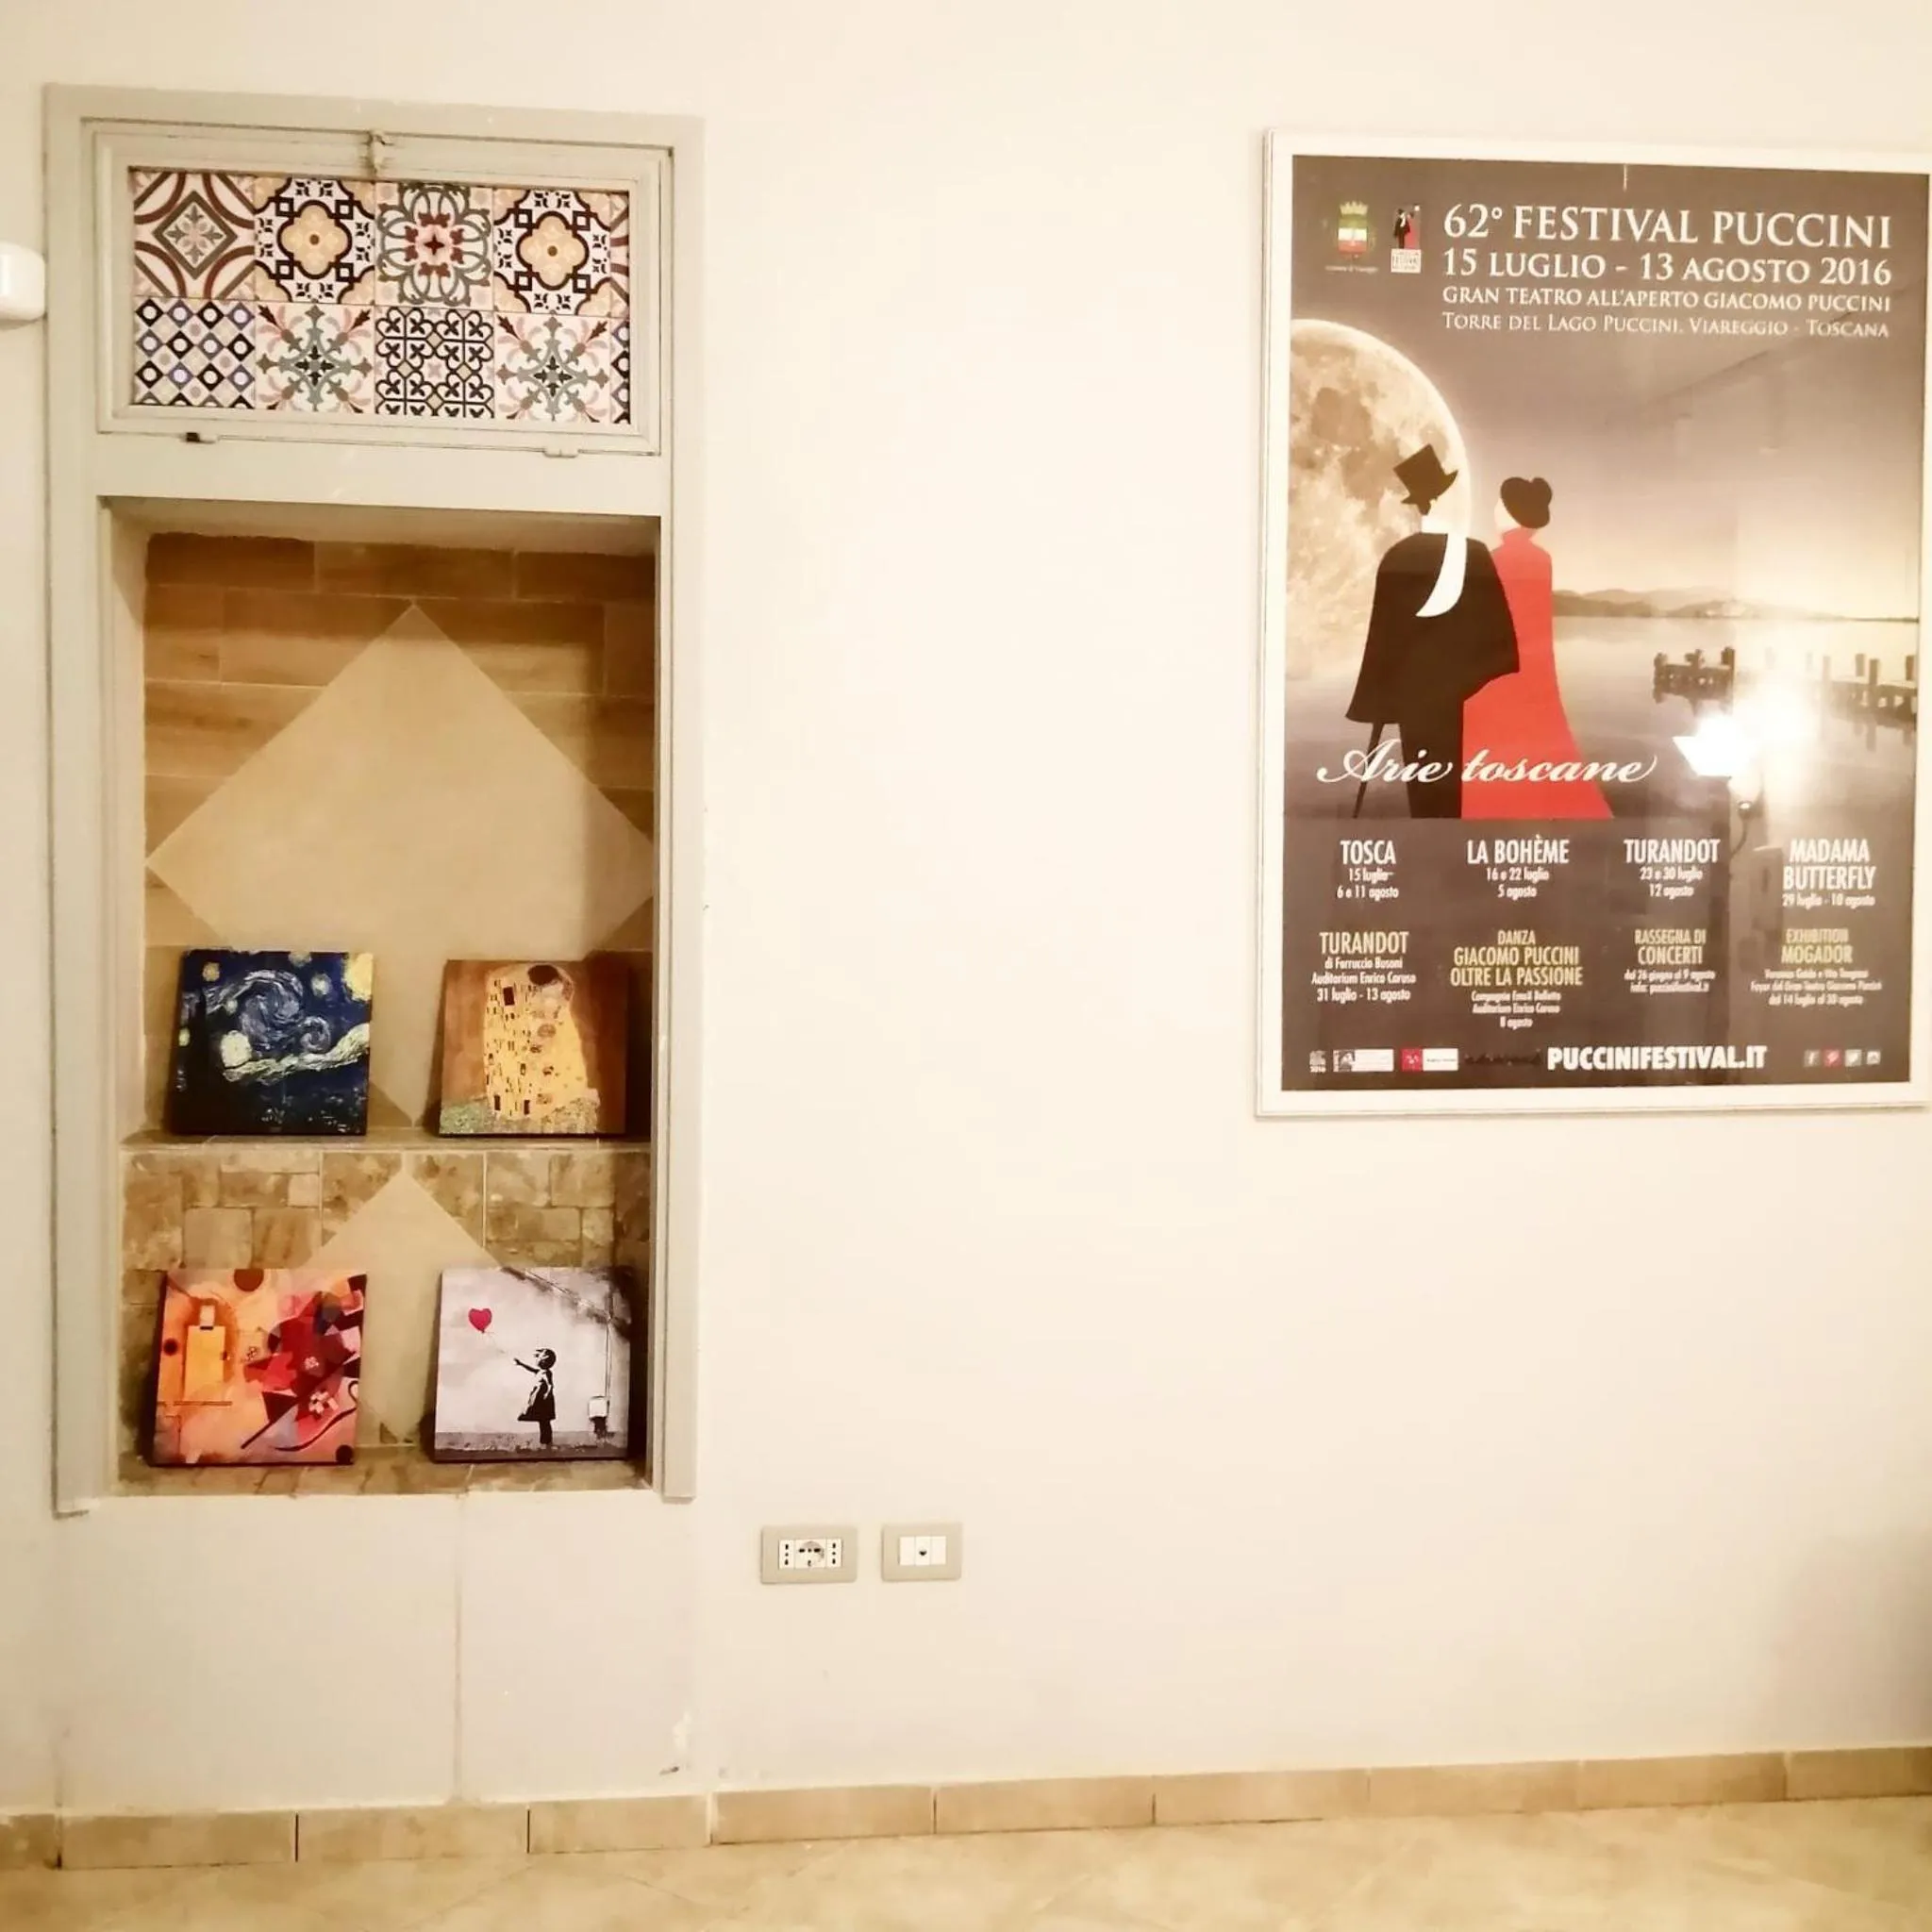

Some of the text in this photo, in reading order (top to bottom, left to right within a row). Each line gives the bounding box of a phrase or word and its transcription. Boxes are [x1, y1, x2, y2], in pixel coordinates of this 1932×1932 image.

[1514, 205, 1698, 243] FESTIVAL
[1713, 210, 1892, 249] PUCCINI
[1443, 247, 1477, 276] 15
[1490, 252, 1606, 279] LUGLIO
[1640, 252, 1674, 280] 13
[1682, 257, 1810, 284] AGOSTO
[1819, 257, 1892, 286] 2016
[1442, 286, 1890, 312] GRAN TEATRO ALL'APERTO GIACOMO PUCCINI
[1316, 739, 1657, 783] Arie toscane
[1340, 840, 1396, 865] TOSCA
[1467, 833, 1570, 864] LA BOHÈME
[1624, 838, 1721, 863] TURANDOT
[1789, 838, 1871, 862] MADAMA
[1349, 867, 1361, 881] 15
[1487, 866, 1499, 881] 16
[1782, 865, 1876, 890] BUTTERFLY
[1337, 885, 1344, 898] 6
[1355, 884, 1365, 898] 11
[1369, 886, 1399, 901] agosto
[1507, 886, 1537, 901] agosto
[1319, 931, 1409, 955] TURANDOT
[1497, 929, 1536, 945] DANZA
[1634, 928, 1707, 944] RASSEGNA DI
[1454, 945, 1580, 966] GIACOMO PUCCINI
[1638, 945, 1703, 965] CONCERTI
[1781, 944, 1854, 964] MOGADOR
[1451, 966, 1583, 987] OLTRE LA PASSIONE
[1317, 987, 1329, 1002] 31
[1331, 986, 1357, 1005] luglio
[1367, 987, 1378, 1001] 13
[1380, 989, 1411, 1004] agosto
[1547, 1045, 1768, 1071] PUCCINIFESTIVAL.IT
